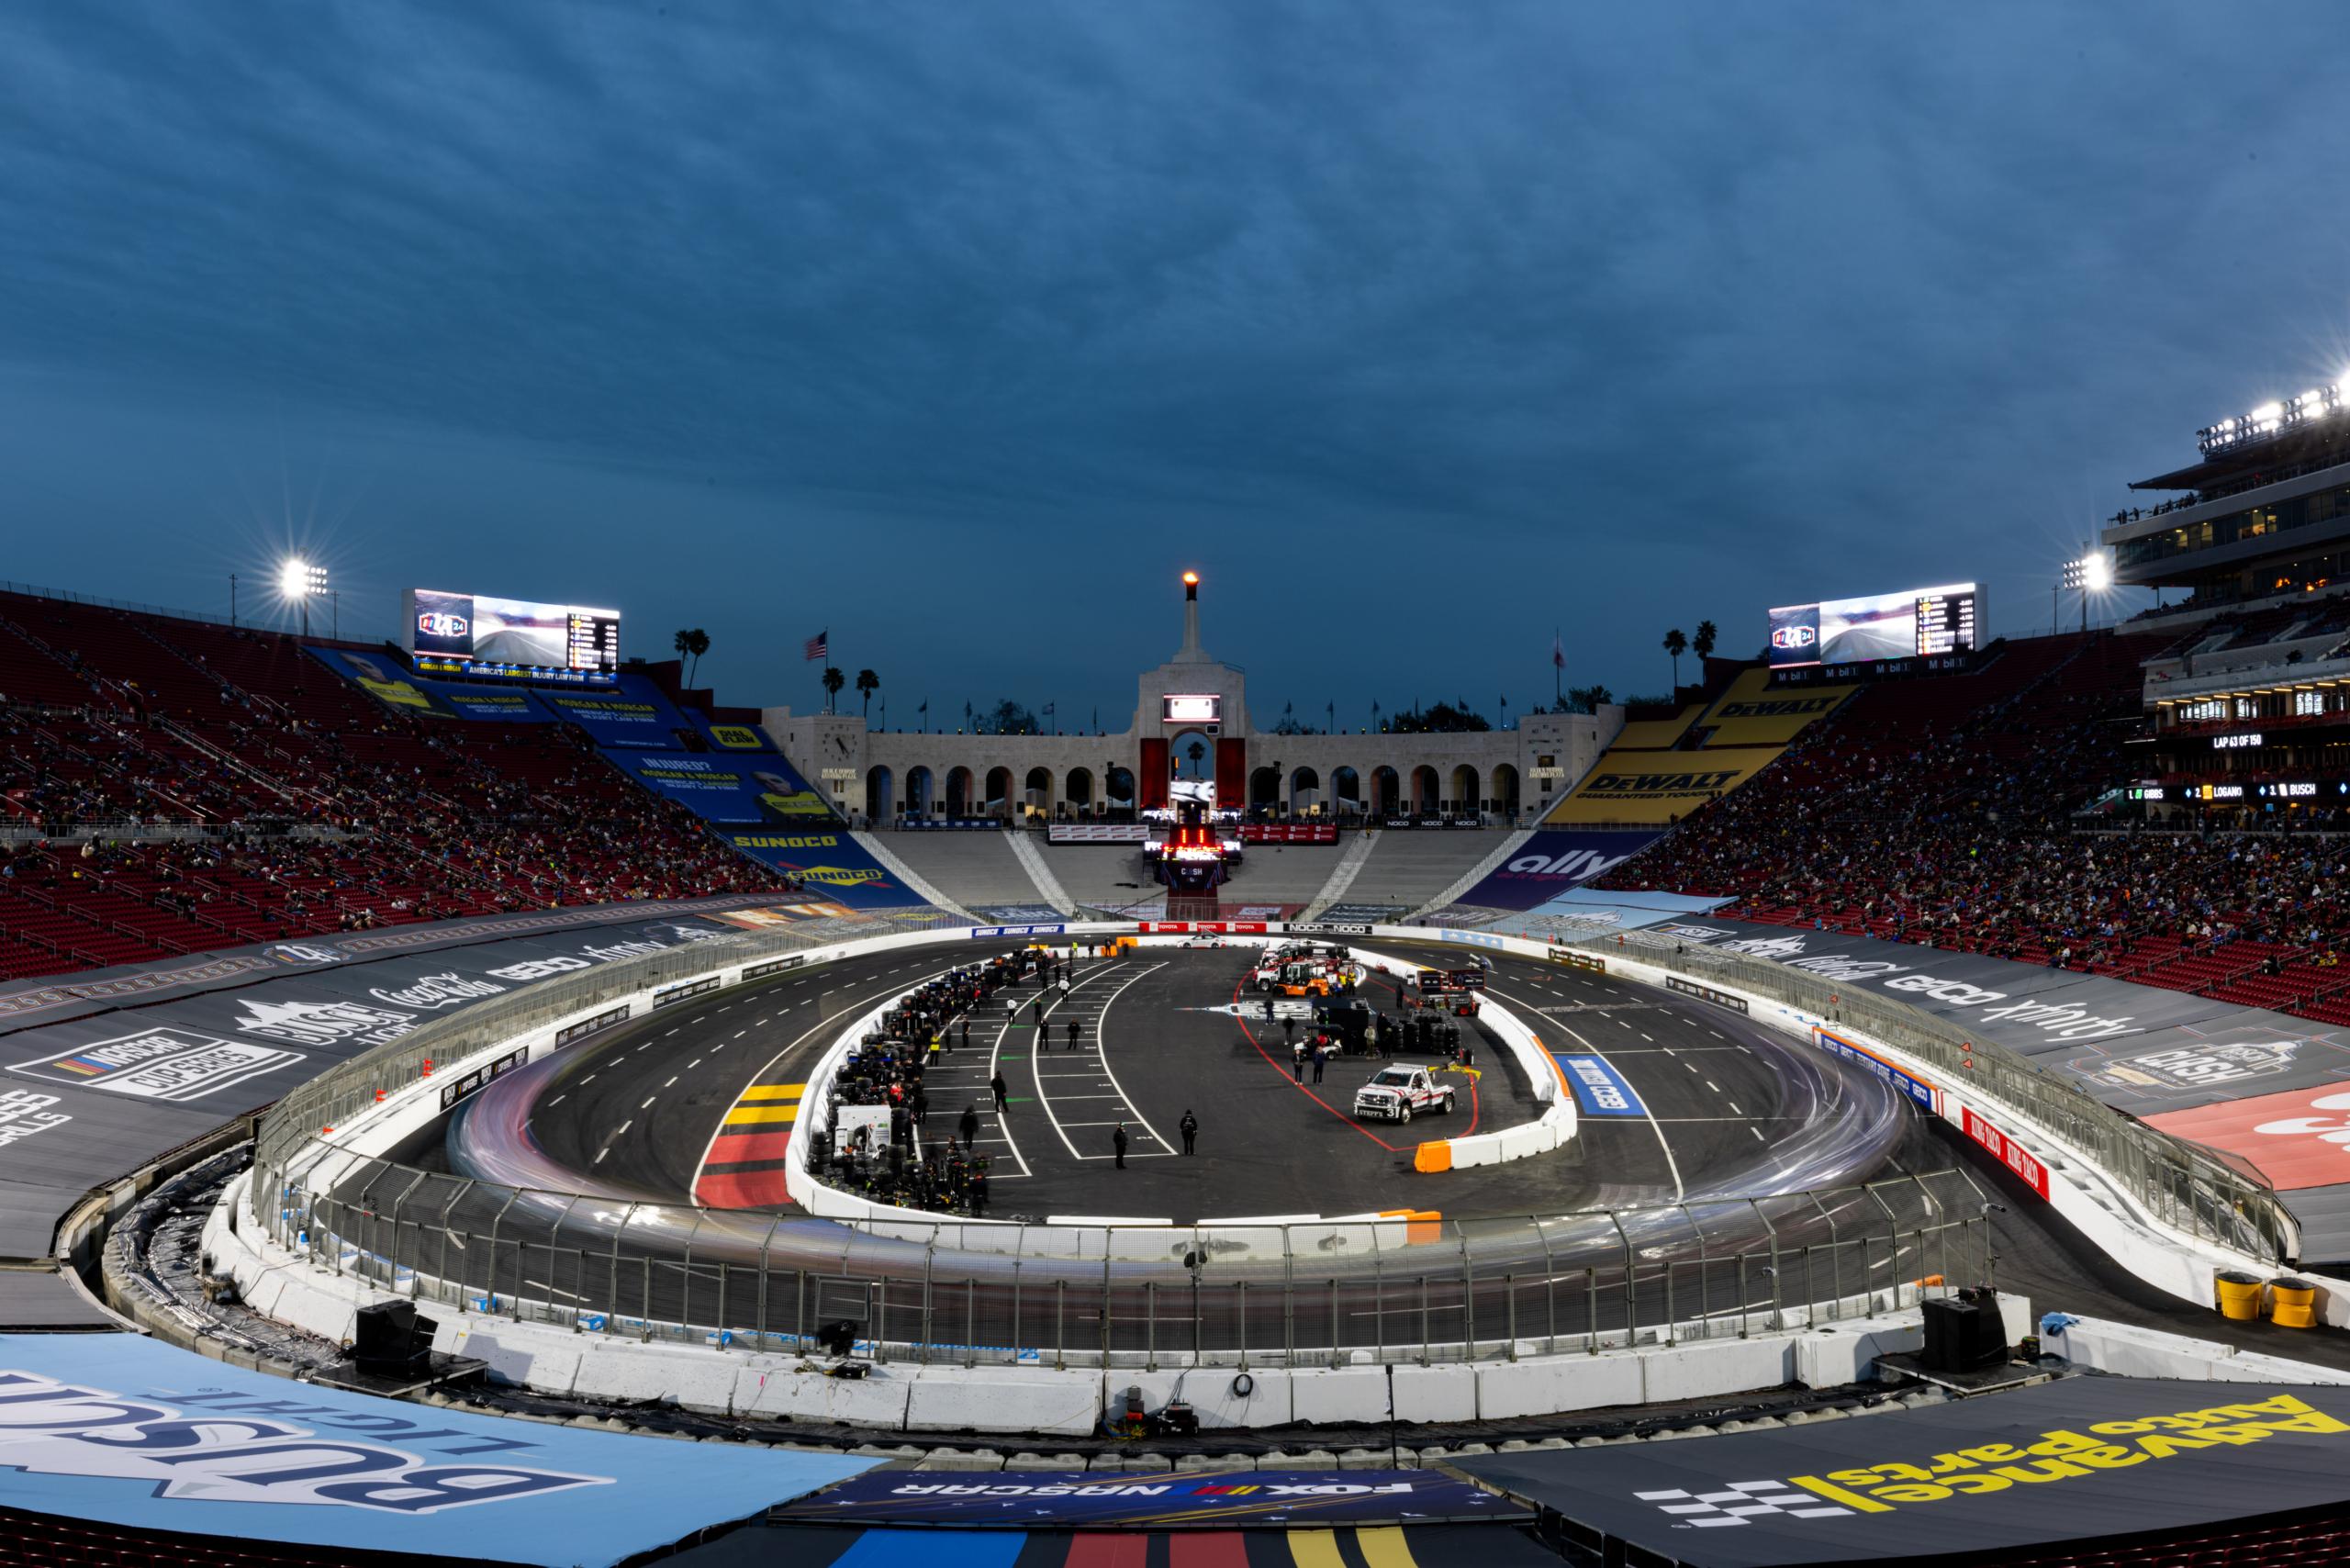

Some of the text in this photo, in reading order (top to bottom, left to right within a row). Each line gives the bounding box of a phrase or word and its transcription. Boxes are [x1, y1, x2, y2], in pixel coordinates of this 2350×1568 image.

[1876, 664, 1900, 673] Mbil
[1929, 657, 1954, 668] Mbil
[469, 666, 504, 676] AMERICA'S
[504, 669, 532, 678] LARGEST
[532, 672, 554, 680] INJURY
[555, 673, 567, 681] LAW
[568, 674, 585, 682] FIRM
[1778, 672, 1801, 681] Mbil
[1826, 668, 1849, 677] Mbil
[2214, 734, 2261, 748] LAP 63 OF 150
[642, 757, 712, 771] INJURED?
[2143, 788, 2164, 799] GIBBS
[2195, 786, 2243, 798] 2. LOGANO
[2269, 784, 2316, 796] 3. BUSCH
[734, 836, 837, 847] SUNOCO
[1507, 849, 1631, 880] ally
[794, 870, 879, 880] SUNOCO
[975, 927, 998, 936] SUNOCO
[1002, 926, 1029, 935] SUNOCO
[1032, 925, 1059, 934] SUNOCO
[1289, 924, 1324, 933] NOCO
[1333, 924, 1366, 934] NOCO
[487, 957, 591, 980] GEICO
[1884, 975, 2009, 1005] GEICO
[256, 1001, 419, 1046] BUSCH
[87, 1036, 191, 1068] NASCAR
[1824, 1038, 1838, 1053] GEICO
[1840, 1046, 1853, 1059] GEICO
[129, 1048, 254, 1090] CUP SERIES
[1876, 1062, 1890, 1082] ZONE
[2133, 1049, 2255, 1084] CLASH
[1895, 1072, 1909, 1091] GEICO
[1912, 1083, 1928, 1102] GEICO
[1387, 1108, 1394, 1117] 3
[1971, 1114, 2001, 1156] KING TACO
[2007, 1141, 2039, 1188] KING TACO
[135, 1390, 543, 1456] LIGHT
[1828, 1394, 2315, 1487] Auto Parts
[1869, 1409, 2350, 1503] Advance
[890, 1482, 1414, 1496] FOX NASCAR
